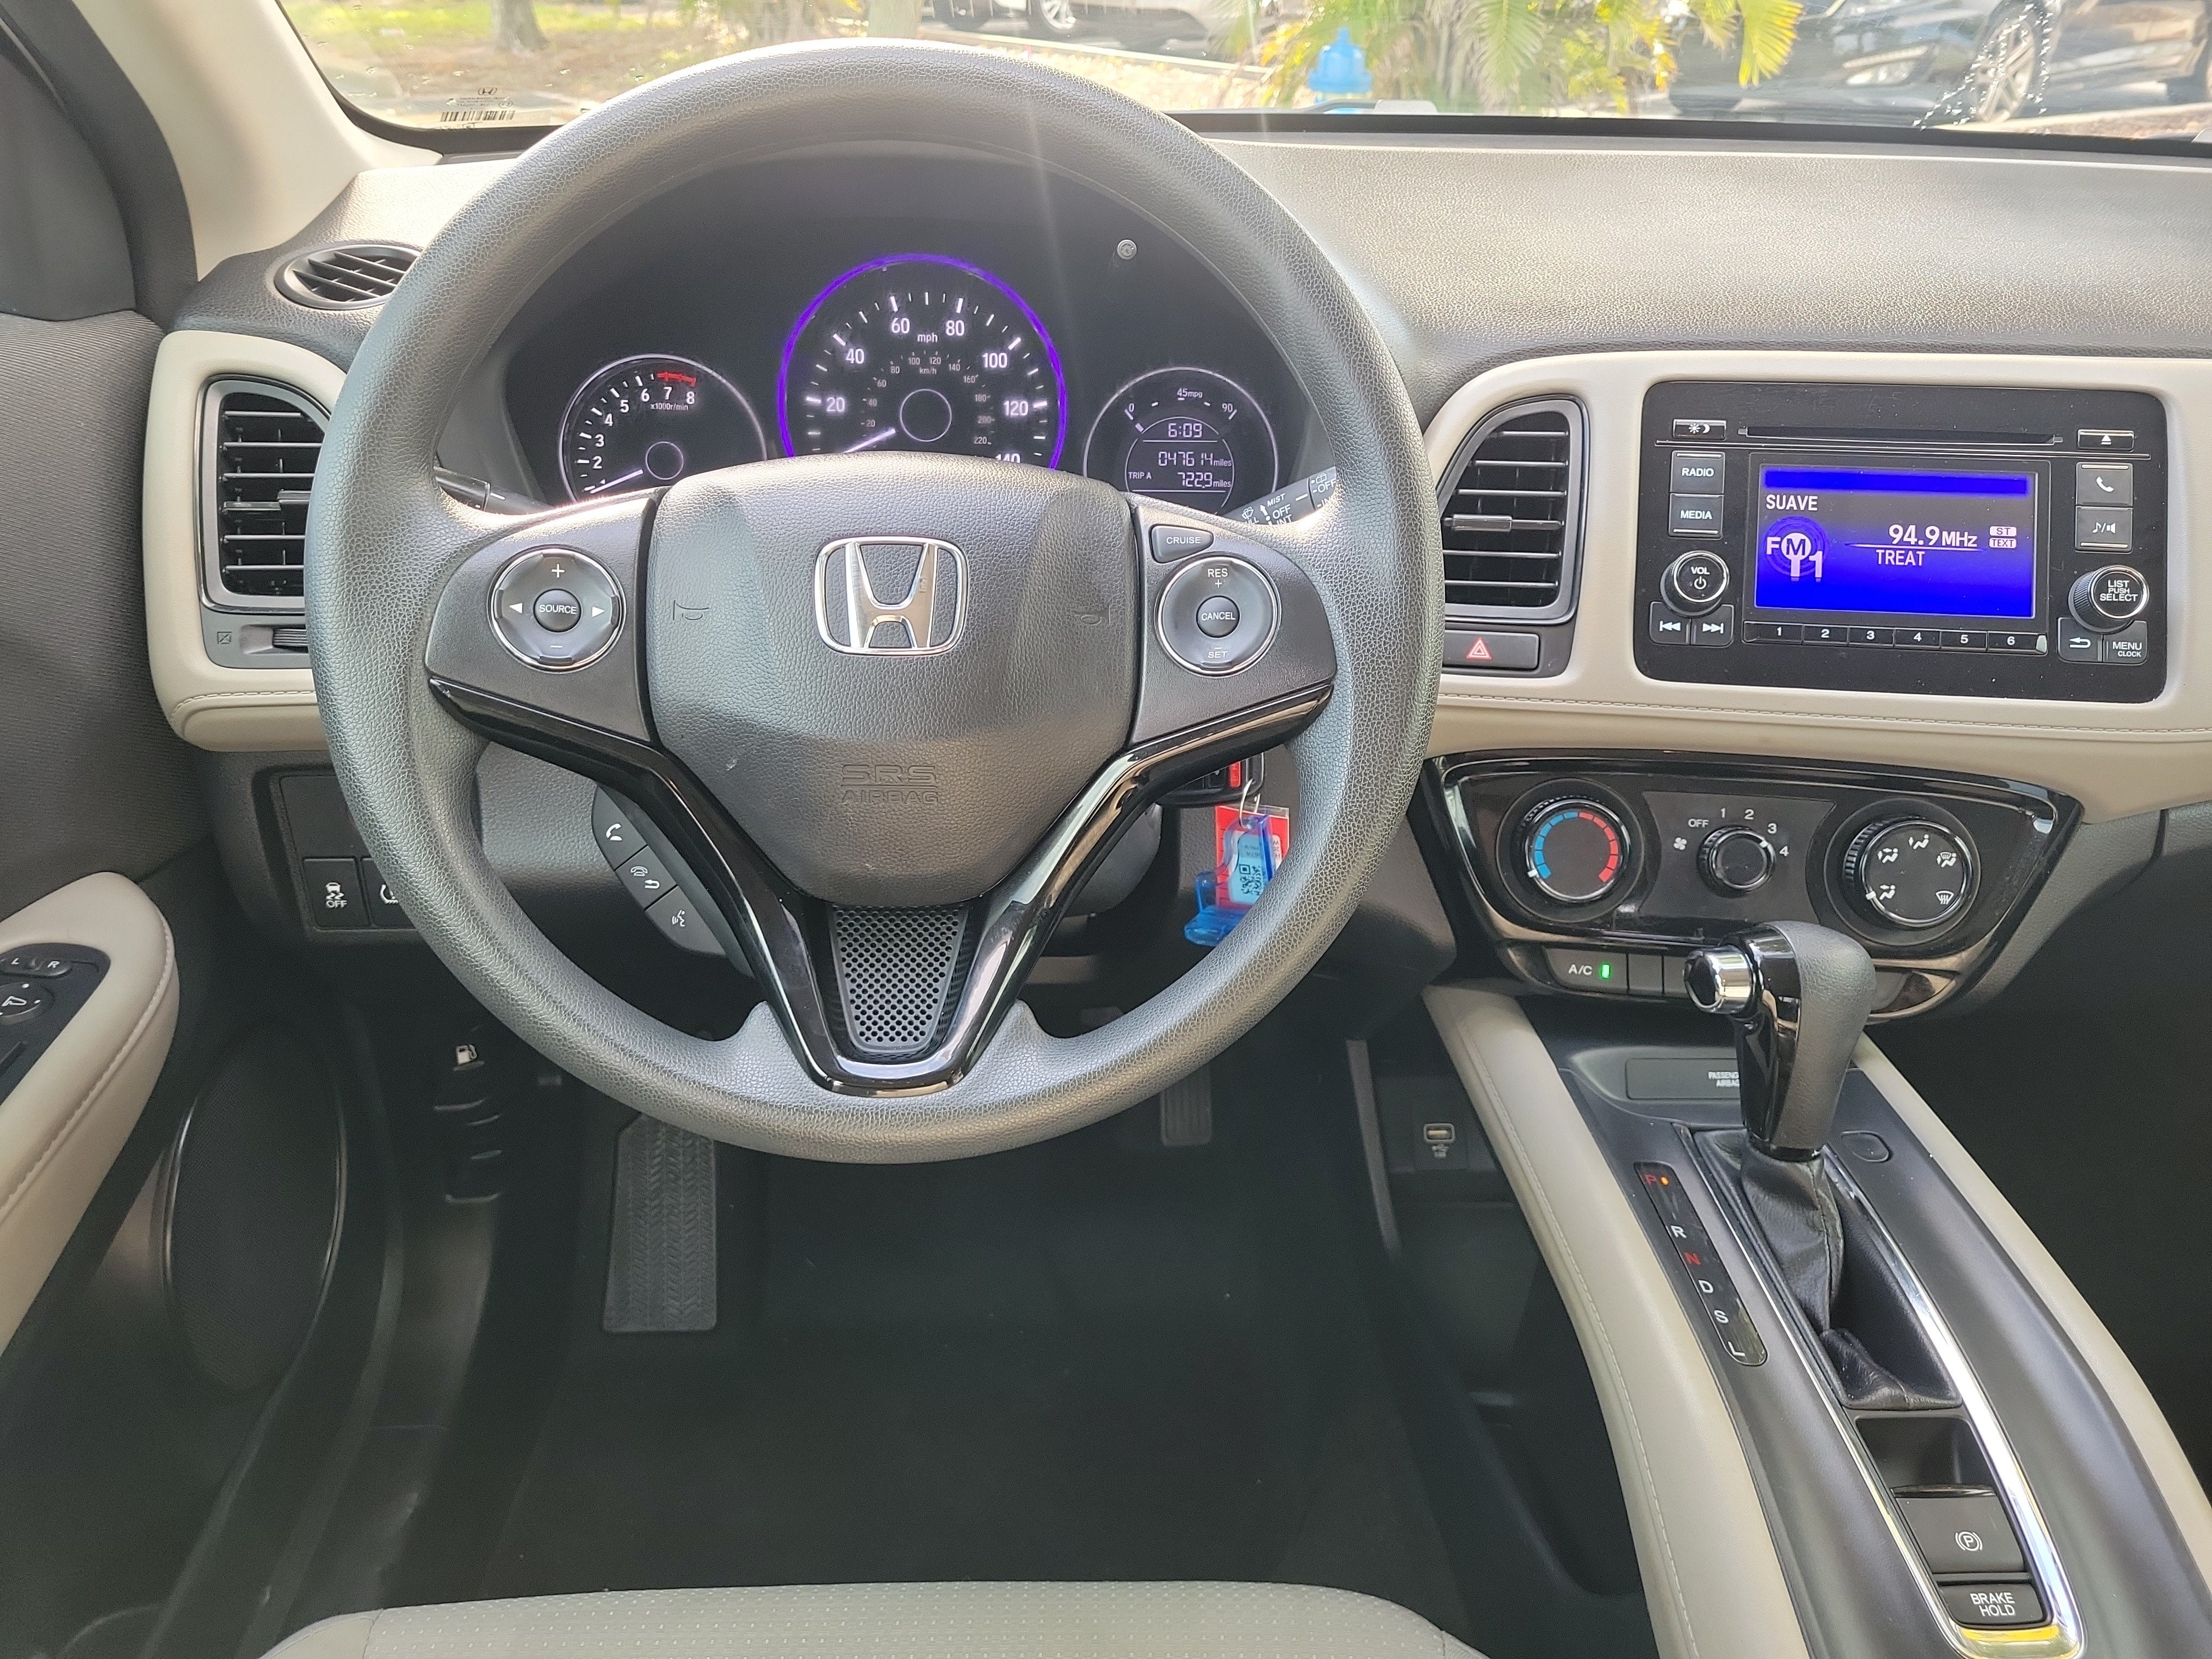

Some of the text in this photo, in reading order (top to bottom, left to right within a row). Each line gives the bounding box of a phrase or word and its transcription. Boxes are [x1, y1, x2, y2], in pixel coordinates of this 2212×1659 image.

[891, 318, 910, 334] 60
[946, 320, 964, 336] 80
[917, 333, 938, 344] mph
[846, 348, 865, 364] 40
[909, 357, 921, 365] 100
[929, 357, 941, 365] 120
[982, 352, 1008, 368] 100
[891, 366, 900, 374] 80
[948, 363, 961, 371] 140
[877, 380, 887, 388] 60
[963, 375, 975, 384] 160
[641, 389, 650, 402] 6
[663, 387, 673, 400] 7
[686, 391, 695, 404] 8
[974, 394, 986, 402] 180
[620, 400, 629, 413] 5
[650, 402, 689, 411] x1000r/min
[826, 397, 845, 413] 20
[868, 398, 878, 407] 40
[1128, 403, 1135, 412] 0
[1222, 403, 1233, 412] 90
[1003, 400, 1028, 416] 120
[605, 413, 613, 426] 4
[866, 420, 876, 428] 20
[1168, 423, 1203, 438] 6:09
[595, 434, 604, 447] 3
[974, 437, 987, 445] 220
[592, 456, 602, 469] 2
[1681, 467, 1714, 477] RADIO
[1318, 478, 1336, 493] OFF
[1267, 493, 1286, 507] MIST
[1766, 494, 1818, 511] SUAVE
[1272, 504, 1291, 519] OFF
[1680, 510, 1712, 520] MEDIA
[1888, 524, 1978, 548] 94.9 MHz
[1996, 527, 2012, 535] ST
[1992, 539, 2015, 548] TEXT
[1876, 549, 1925, 566] TREAT
[1207, 568, 1228, 578] RES
[1691, 566, 1710, 574] VOL
[2108, 580, 2130, 588] LIST
[2100, 593, 2138, 602] SELECT
[539, 604, 577, 615] SOURCE
[1201, 612, 1236, 621] CANCEL
[1776, 627, 1782, 636] 1
[1821, 629, 1830, 639] 2
[1866, 631, 1875, 640] 3
[1913, 633, 1922, 642] 4
[1960, 634, 1969, 644] 5
[2007, 636, 2016, 646] 6
[2112, 641, 2142, 650] MENU
[842, 764, 938, 784] SRS
[841, 789, 939, 804] AIRBAG
[1720, 808, 1726, 817] 1
[1745, 809, 1754, 820] 2
[1688, 819, 1709, 827] OFF
[1768, 823, 1777, 833] 3
[1779, 846, 1789, 856] 4
[326, 900, 347, 909] OFF
[1568, 964, 1593, 975] A/C
[1671, 1225, 1687, 1239] R
[1684, 1252, 1701, 1266] N
[1698, 1280, 1714, 1294] D
[1714, 1310, 1729, 1323] S
[1728, 1341, 1745, 1357] L
[1970, 1592, 2016, 1605] BRAKE
[1979, 1605, 2016, 1617] HOLD
